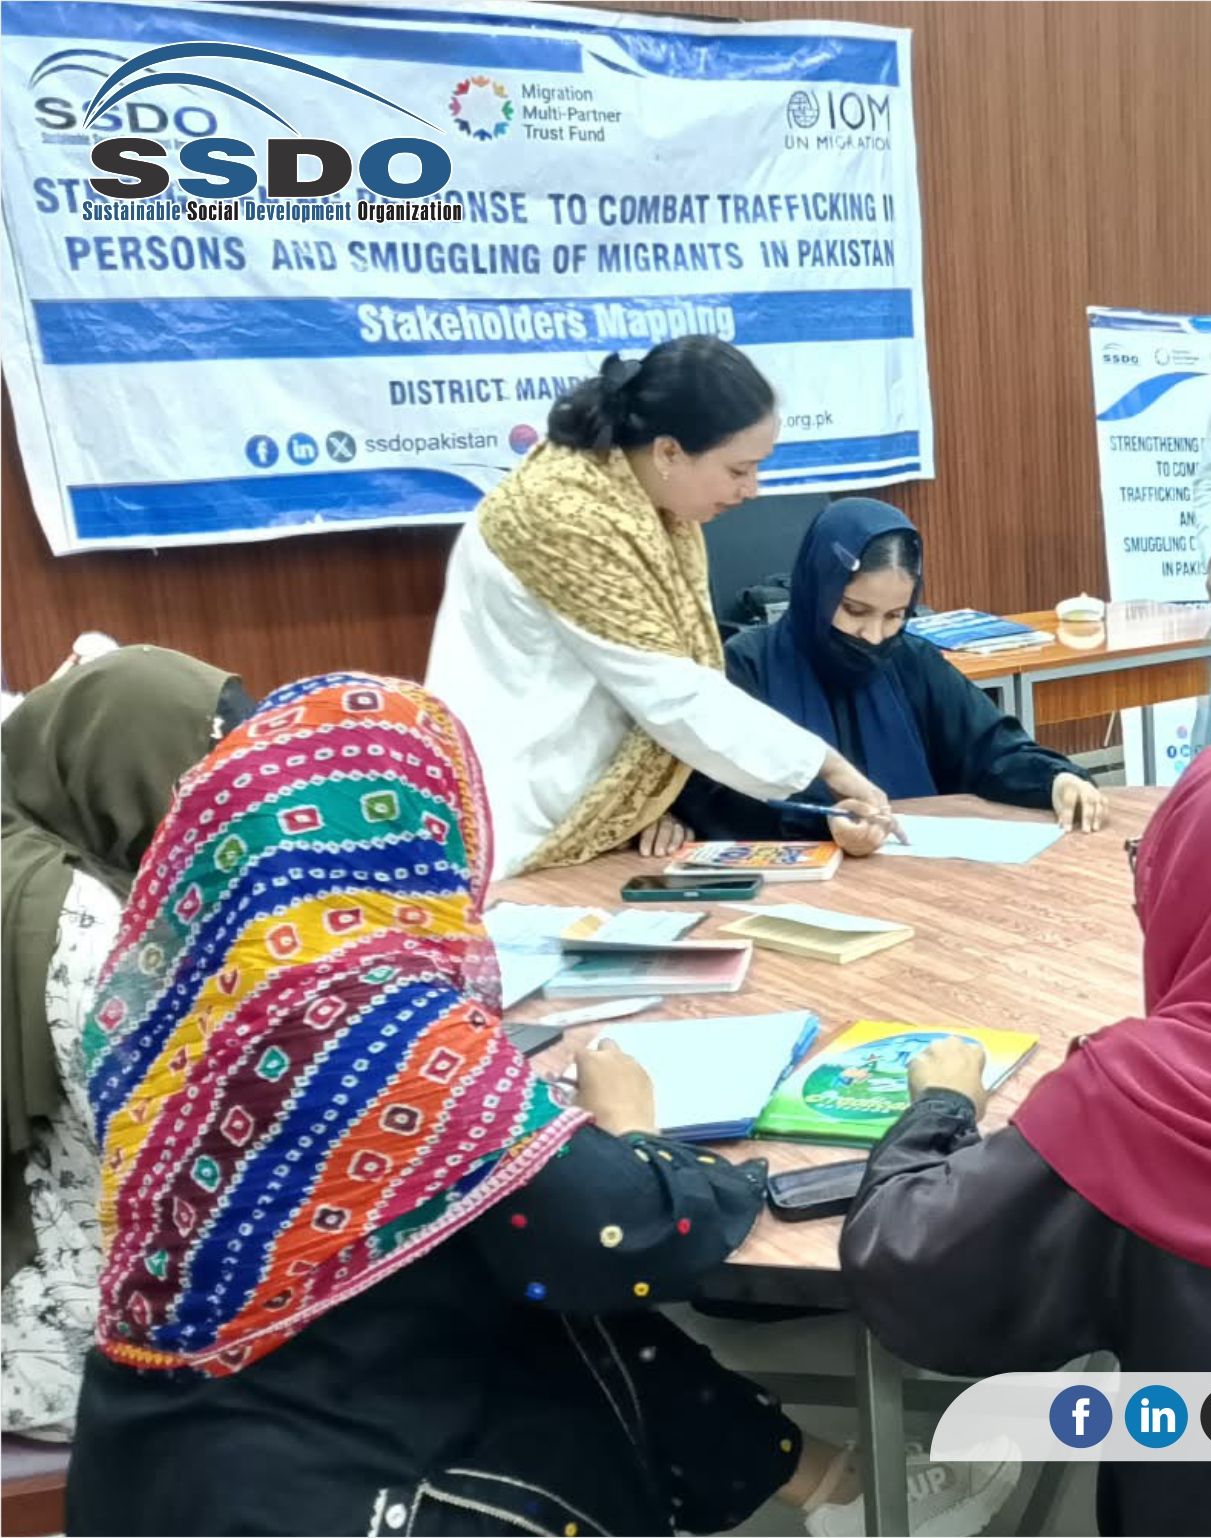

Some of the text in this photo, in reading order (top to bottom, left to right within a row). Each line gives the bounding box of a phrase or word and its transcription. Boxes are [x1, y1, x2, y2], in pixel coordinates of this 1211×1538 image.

[522, 83, 593, 103] Migration
[34, 97, 217, 137] SSDO
[523, 105, 622, 122] Multi-Partner
[828, 90, 890, 131] IOM
[523, 124, 605, 142] Trust Fund
[785, 135, 808, 150] UN
[548, 193, 587, 225] TO
[599, 193, 709, 226] COMBAT
[717, 192, 877, 224] TRAFFICKING
[65, 235, 895, 275] PERSONS AND SMUGGLING OF MIGRANTS IN PAKISTAN
[357, 301, 735, 343] Stakeholders Mapping
[389, 378, 505, 406] DISTRICT
[364, 432, 498, 455] ssdopakistan
[1110, 435, 1199, 453] STRENGTHENING
[1156, 460, 1170, 477] TO
[1119, 486, 1190, 502] TRAFFICKING
[1123, 535, 1187, 552] SMUGGLING
[1162, 560, 1174, 577] IN
